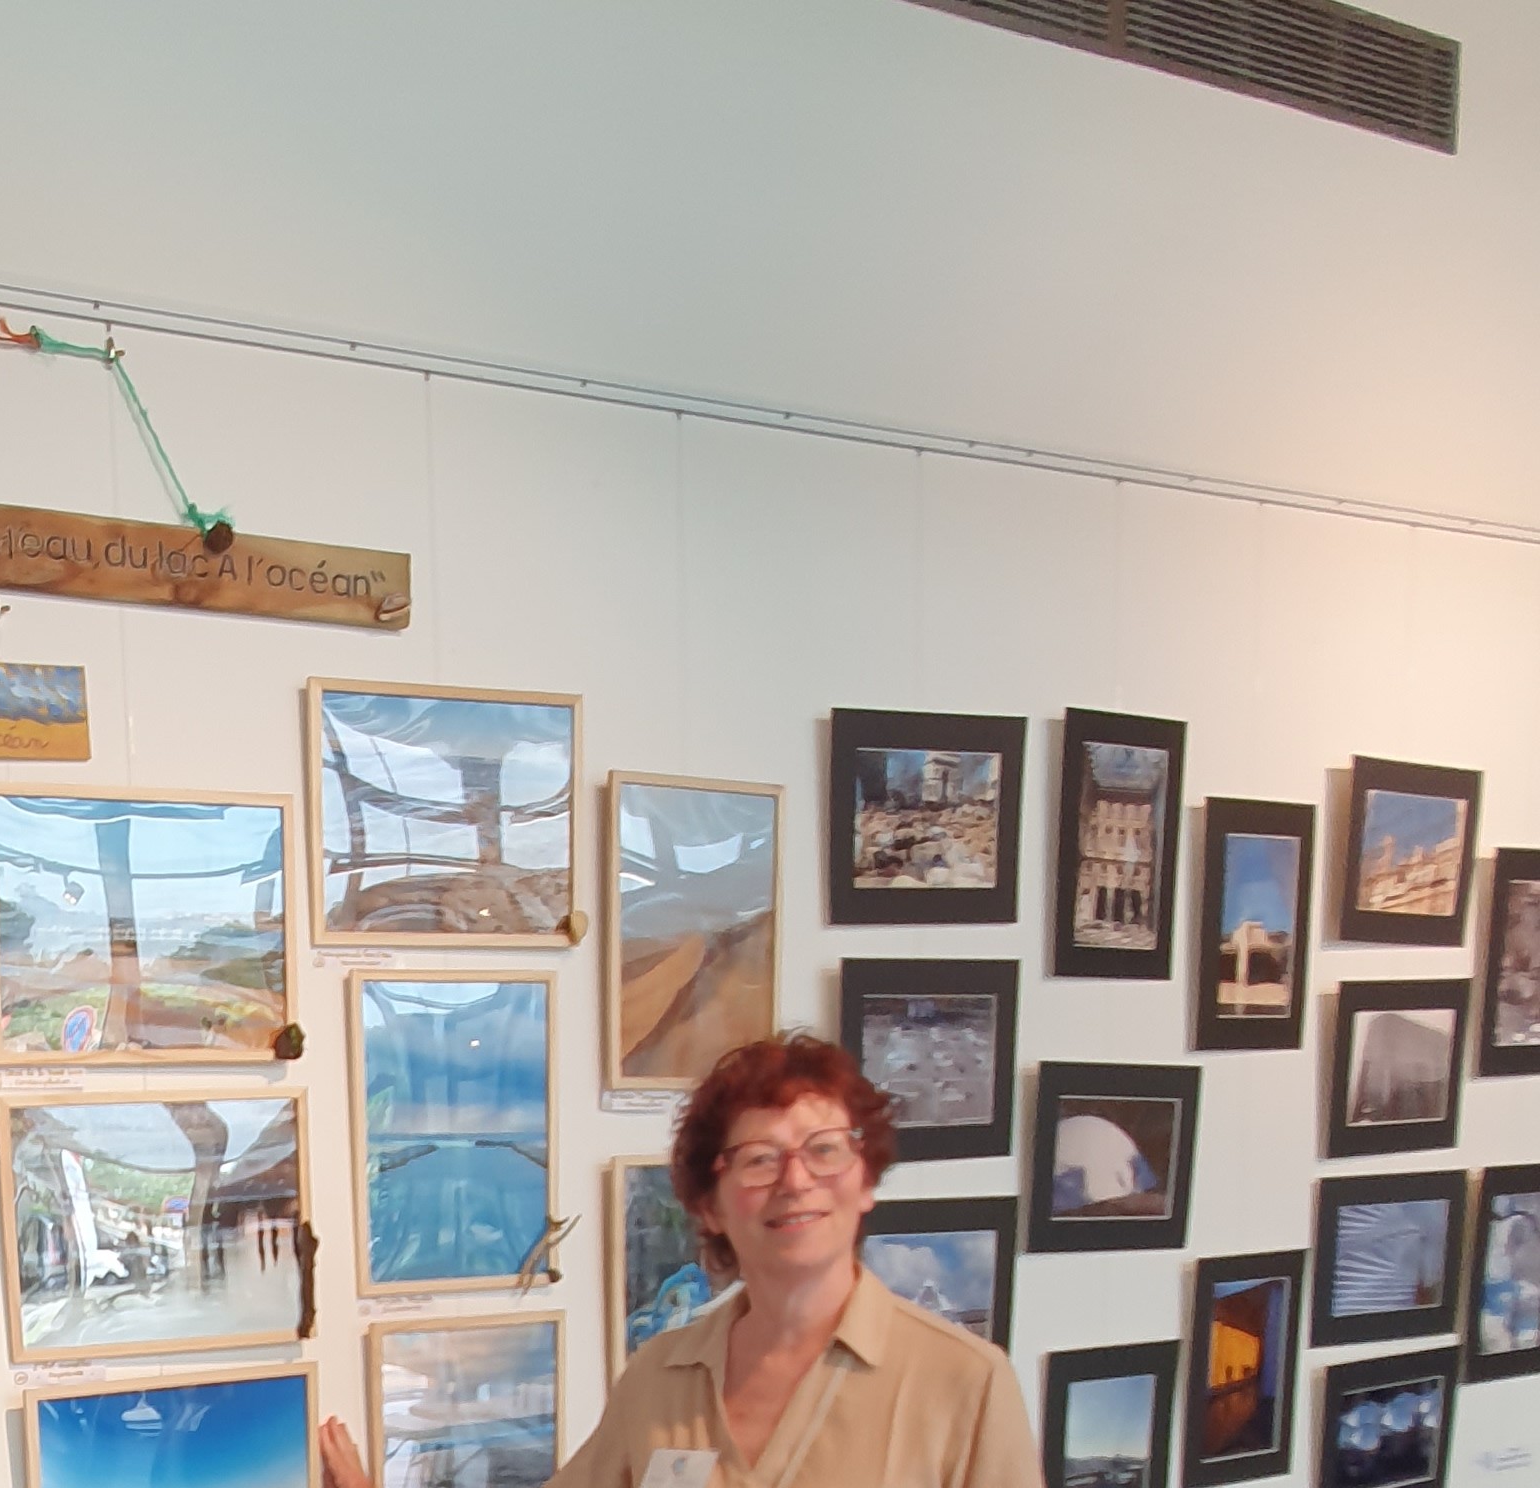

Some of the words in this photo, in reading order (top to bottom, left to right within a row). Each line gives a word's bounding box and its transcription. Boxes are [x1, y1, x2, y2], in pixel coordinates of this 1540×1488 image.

[104, 535, 148, 570] du
[158, 540, 209, 579] lac
[218, 553, 237, 578] A
